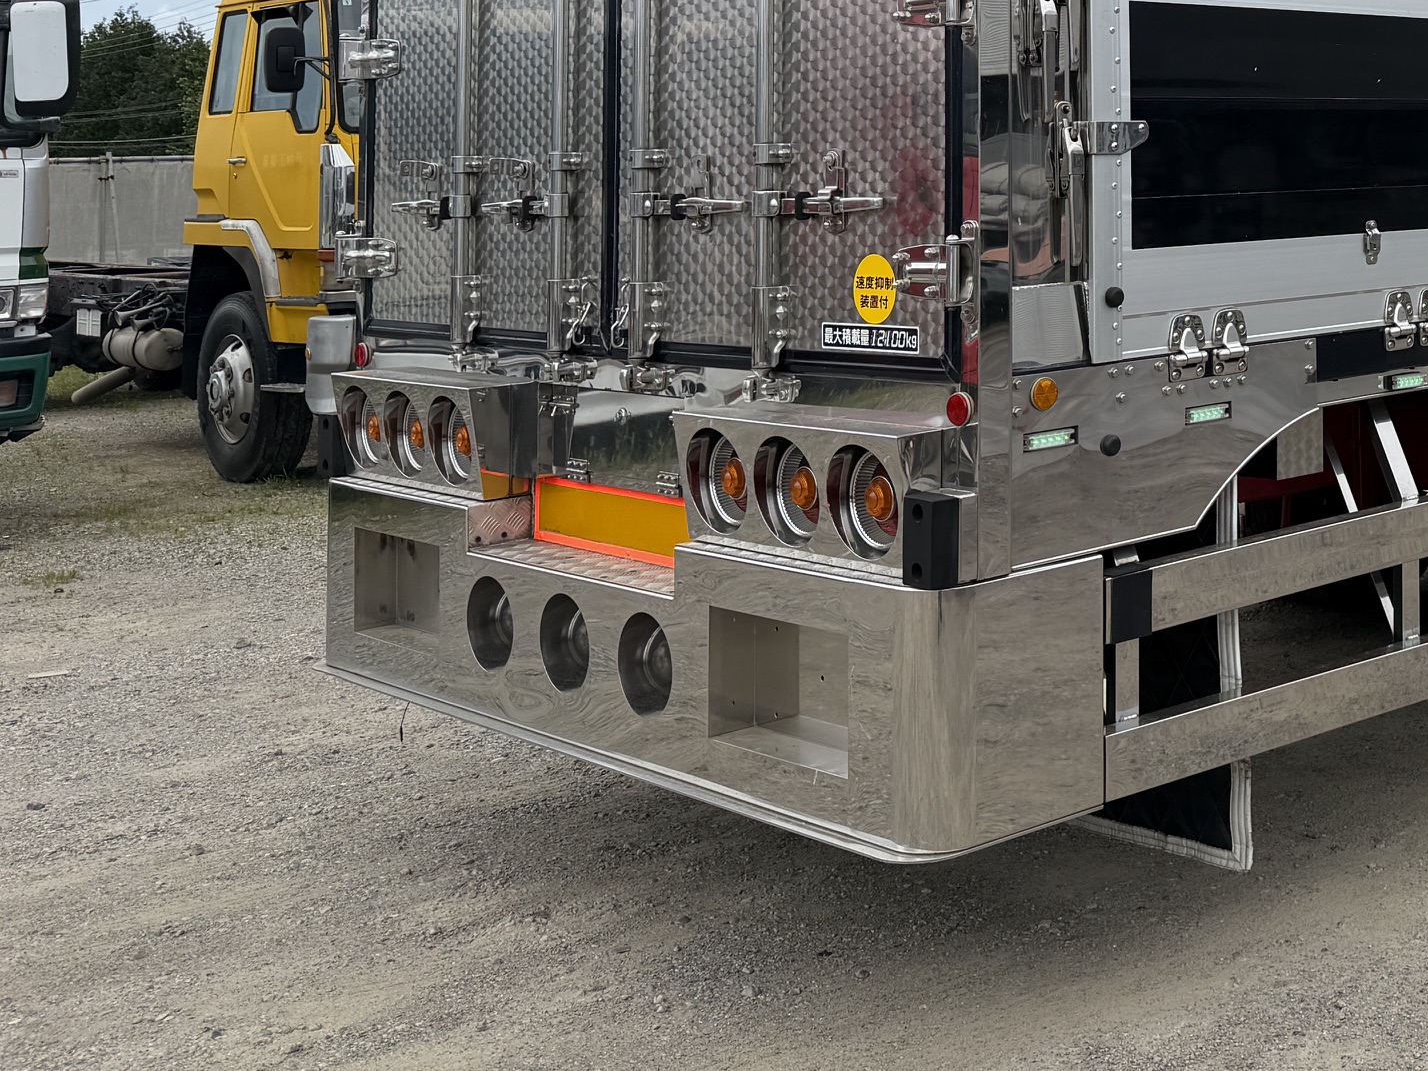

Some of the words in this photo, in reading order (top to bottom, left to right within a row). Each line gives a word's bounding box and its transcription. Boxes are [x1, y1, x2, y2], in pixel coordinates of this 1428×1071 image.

[856, 276, 894, 290] 速度抑制
[860, 295, 888, 309] 装置付
